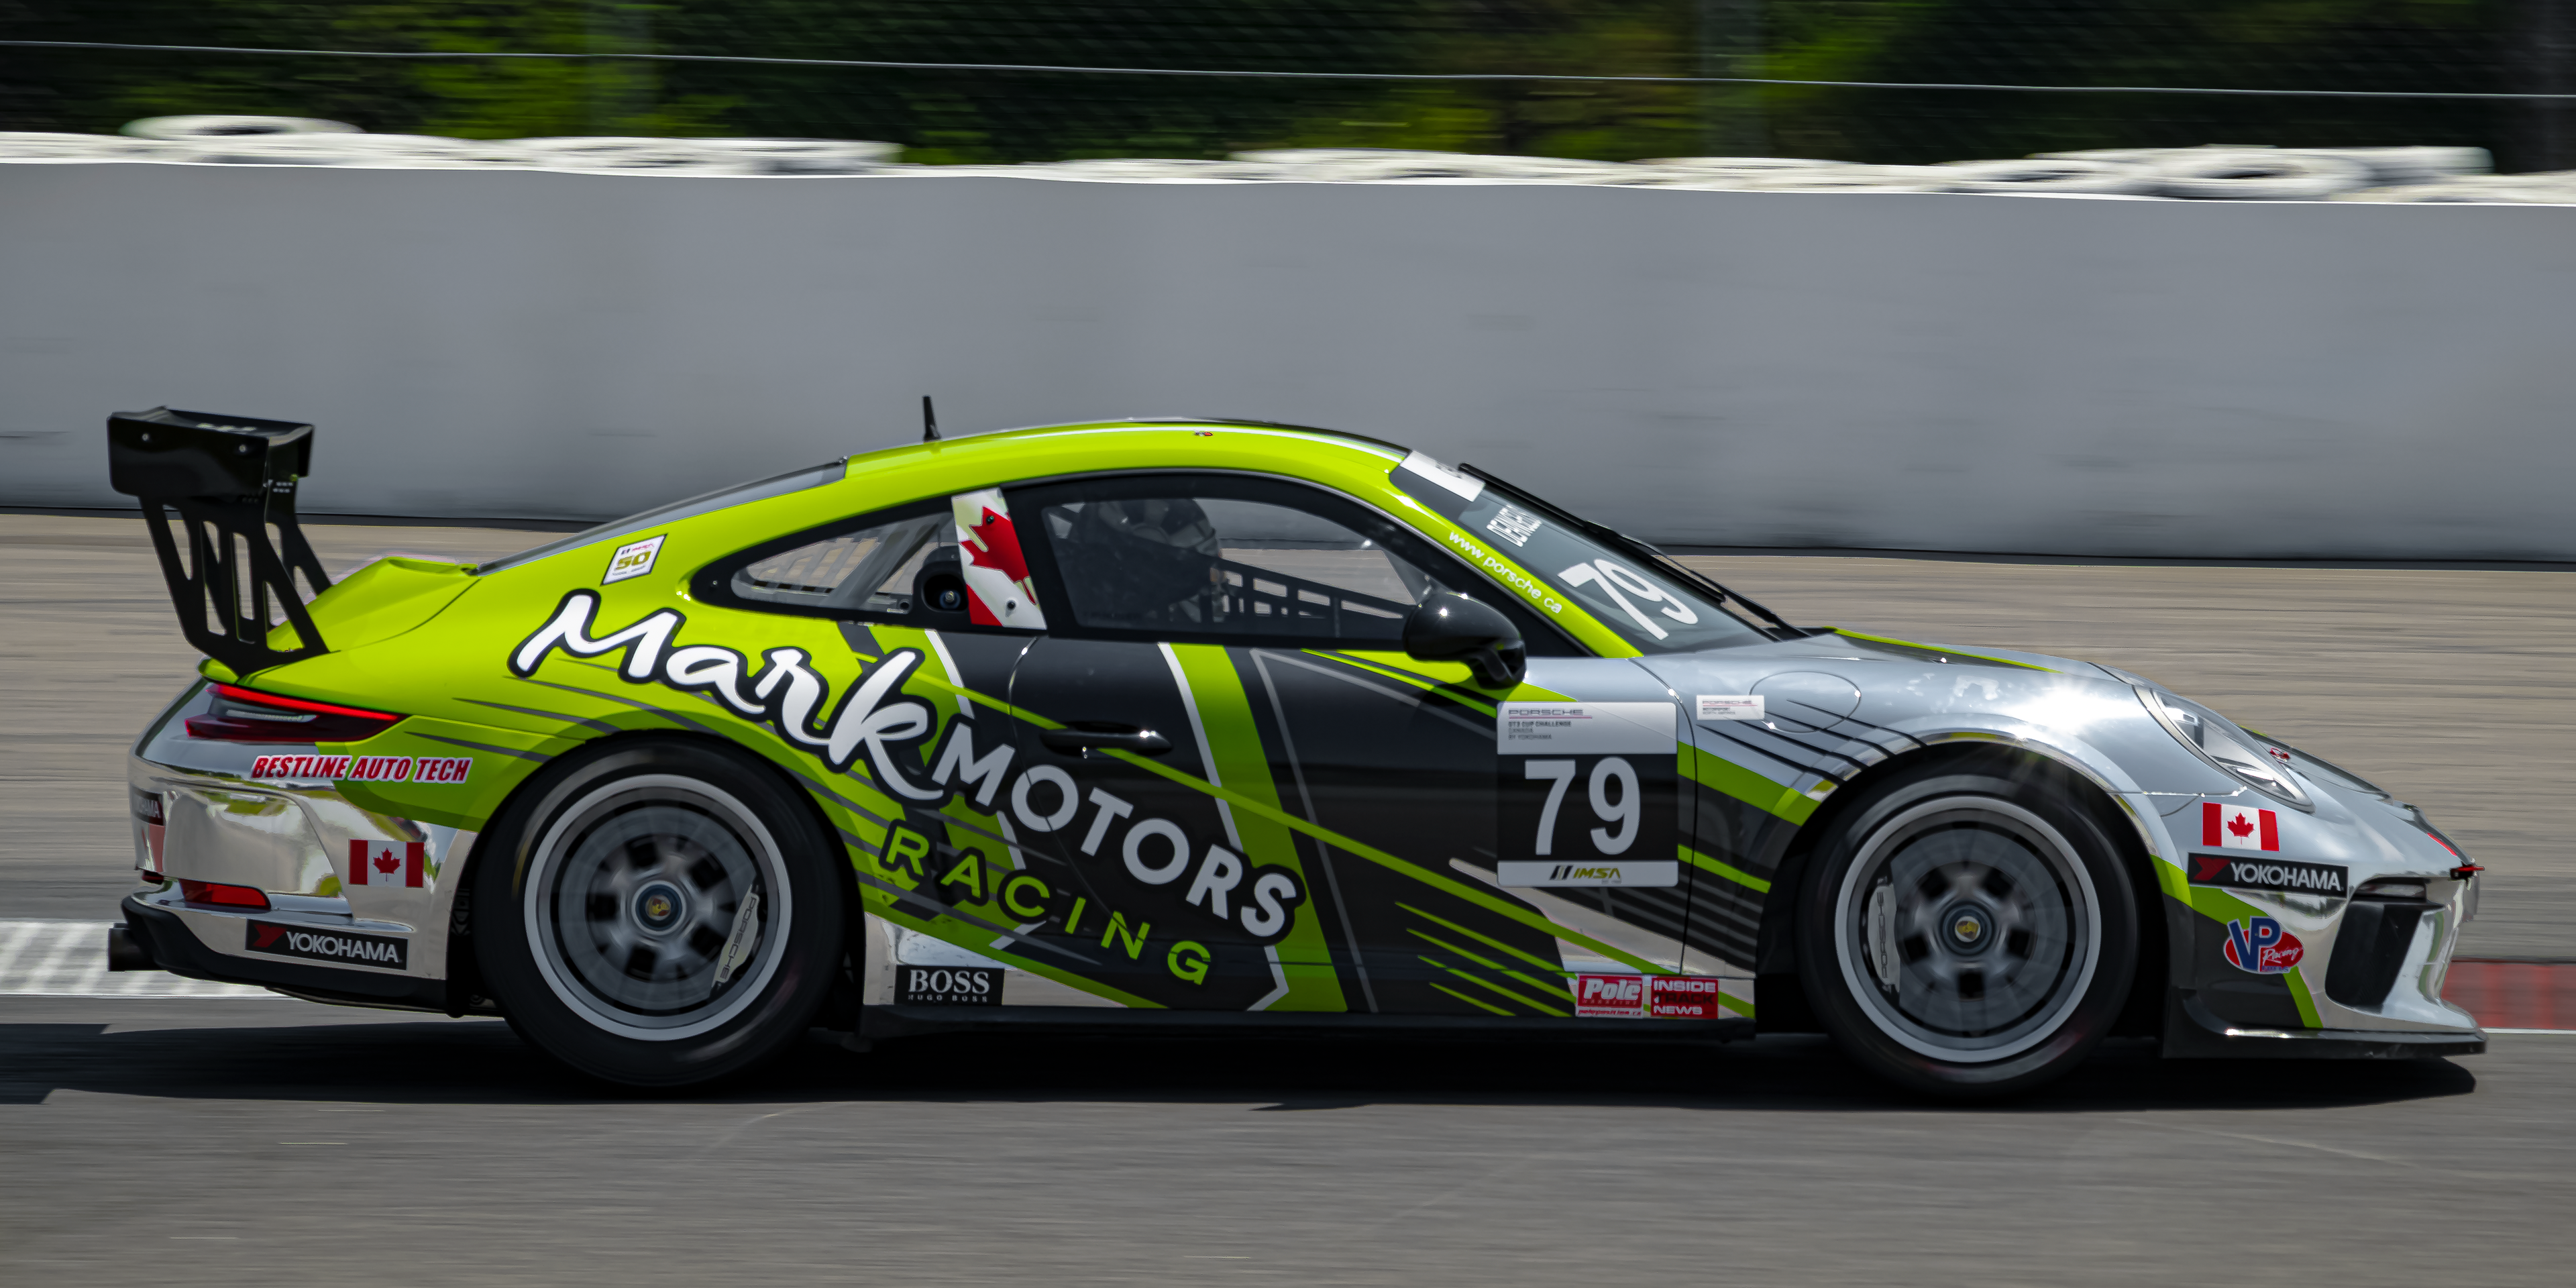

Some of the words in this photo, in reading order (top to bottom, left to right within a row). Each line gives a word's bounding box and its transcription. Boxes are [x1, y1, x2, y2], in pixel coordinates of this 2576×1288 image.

[615, 550, 651, 570] 50
[1556, 558, 1699, 640] 79
[250, 756, 347, 779] BESTLINE
[350, 757, 411, 780] AUTO
[415, 759, 471, 782] TECH
[515, 593, 945, 800] Mark
[931, 721, 1297, 937] MOTORS
[1525, 757, 1641, 855] 79
[2231, 861, 2341, 892] YOKOHAMA
[886, 826, 1212, 985] RACING
[286, 931, 398, 963] YOKOHAMA
[719, 896, 757, 979] PORSCHE
[2228, 916, 2282, 972] VP
[908, 969, 990, 994] BOSS
[1583, 978, 1641, 1001] Pole
[1654, 980, 1716, 993] INSIDE
[1654, 993, 1714, 1004] TRACK
[1654, 1005, 1703, 1014] NEWS
